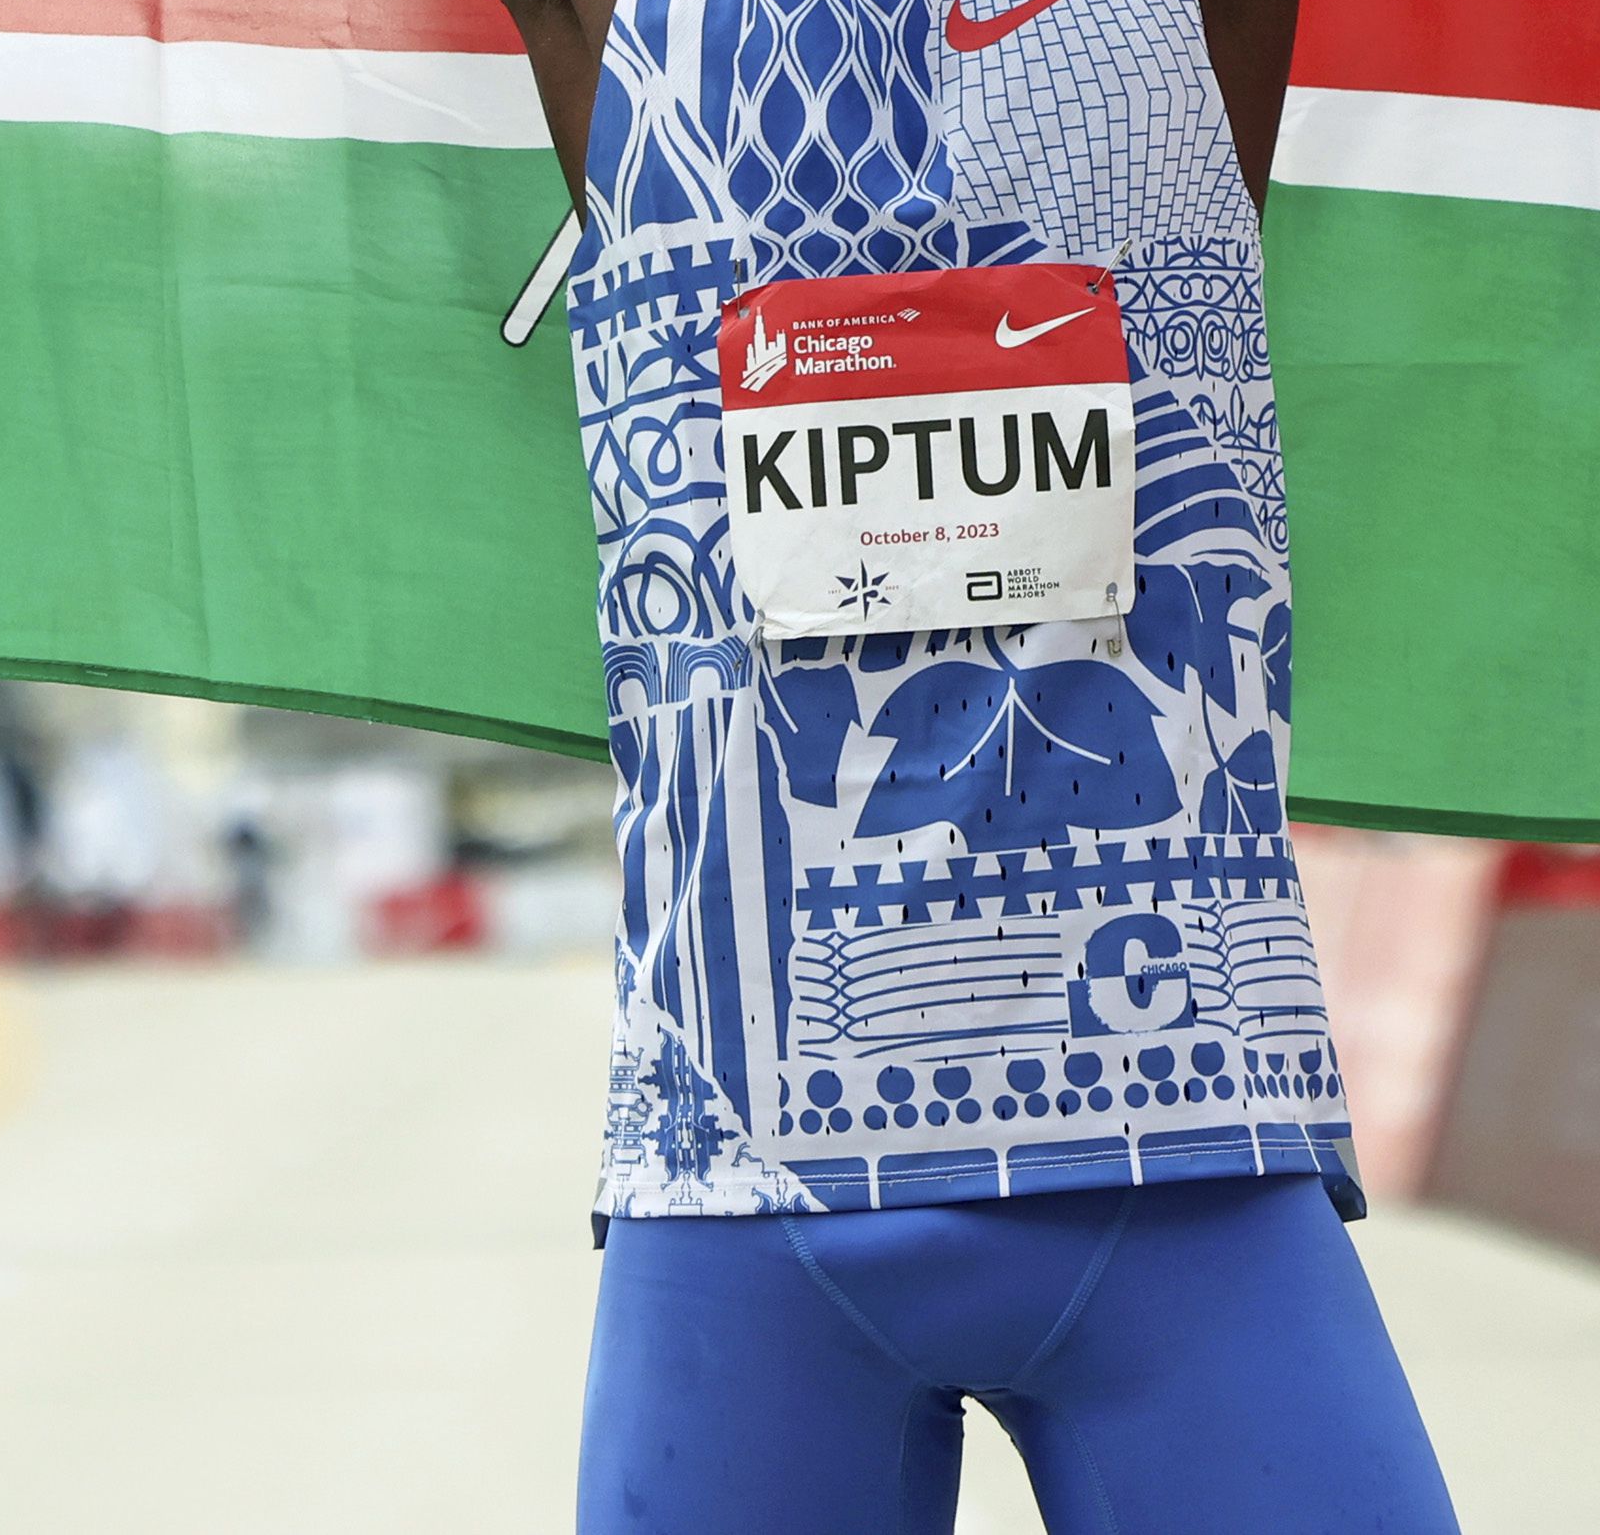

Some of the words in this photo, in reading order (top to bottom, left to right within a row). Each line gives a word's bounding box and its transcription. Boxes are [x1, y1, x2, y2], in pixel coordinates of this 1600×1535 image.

[792, 319, 824, 330] BANK
[826, 318, 840, 328] OF
[843, 314, 896, 327] AMERICA
[793, 334, 873, 354] Chicago
[743, 408, 1112, 514] KIPTUM
[860, 529, 929, 546] October
[935, 526, 951, 542] 8,
[956, 523, 1000, 539] 2023
[1007, 568, 1042, 577] ABBOTT
[1007, 576, 1040, 584] WORLD
[1008, 581, 1060, 592] MARATHON
[1008, 590, 1046, 599] MAJORS
[1140, 961, 1188, 975] CHICAGO
